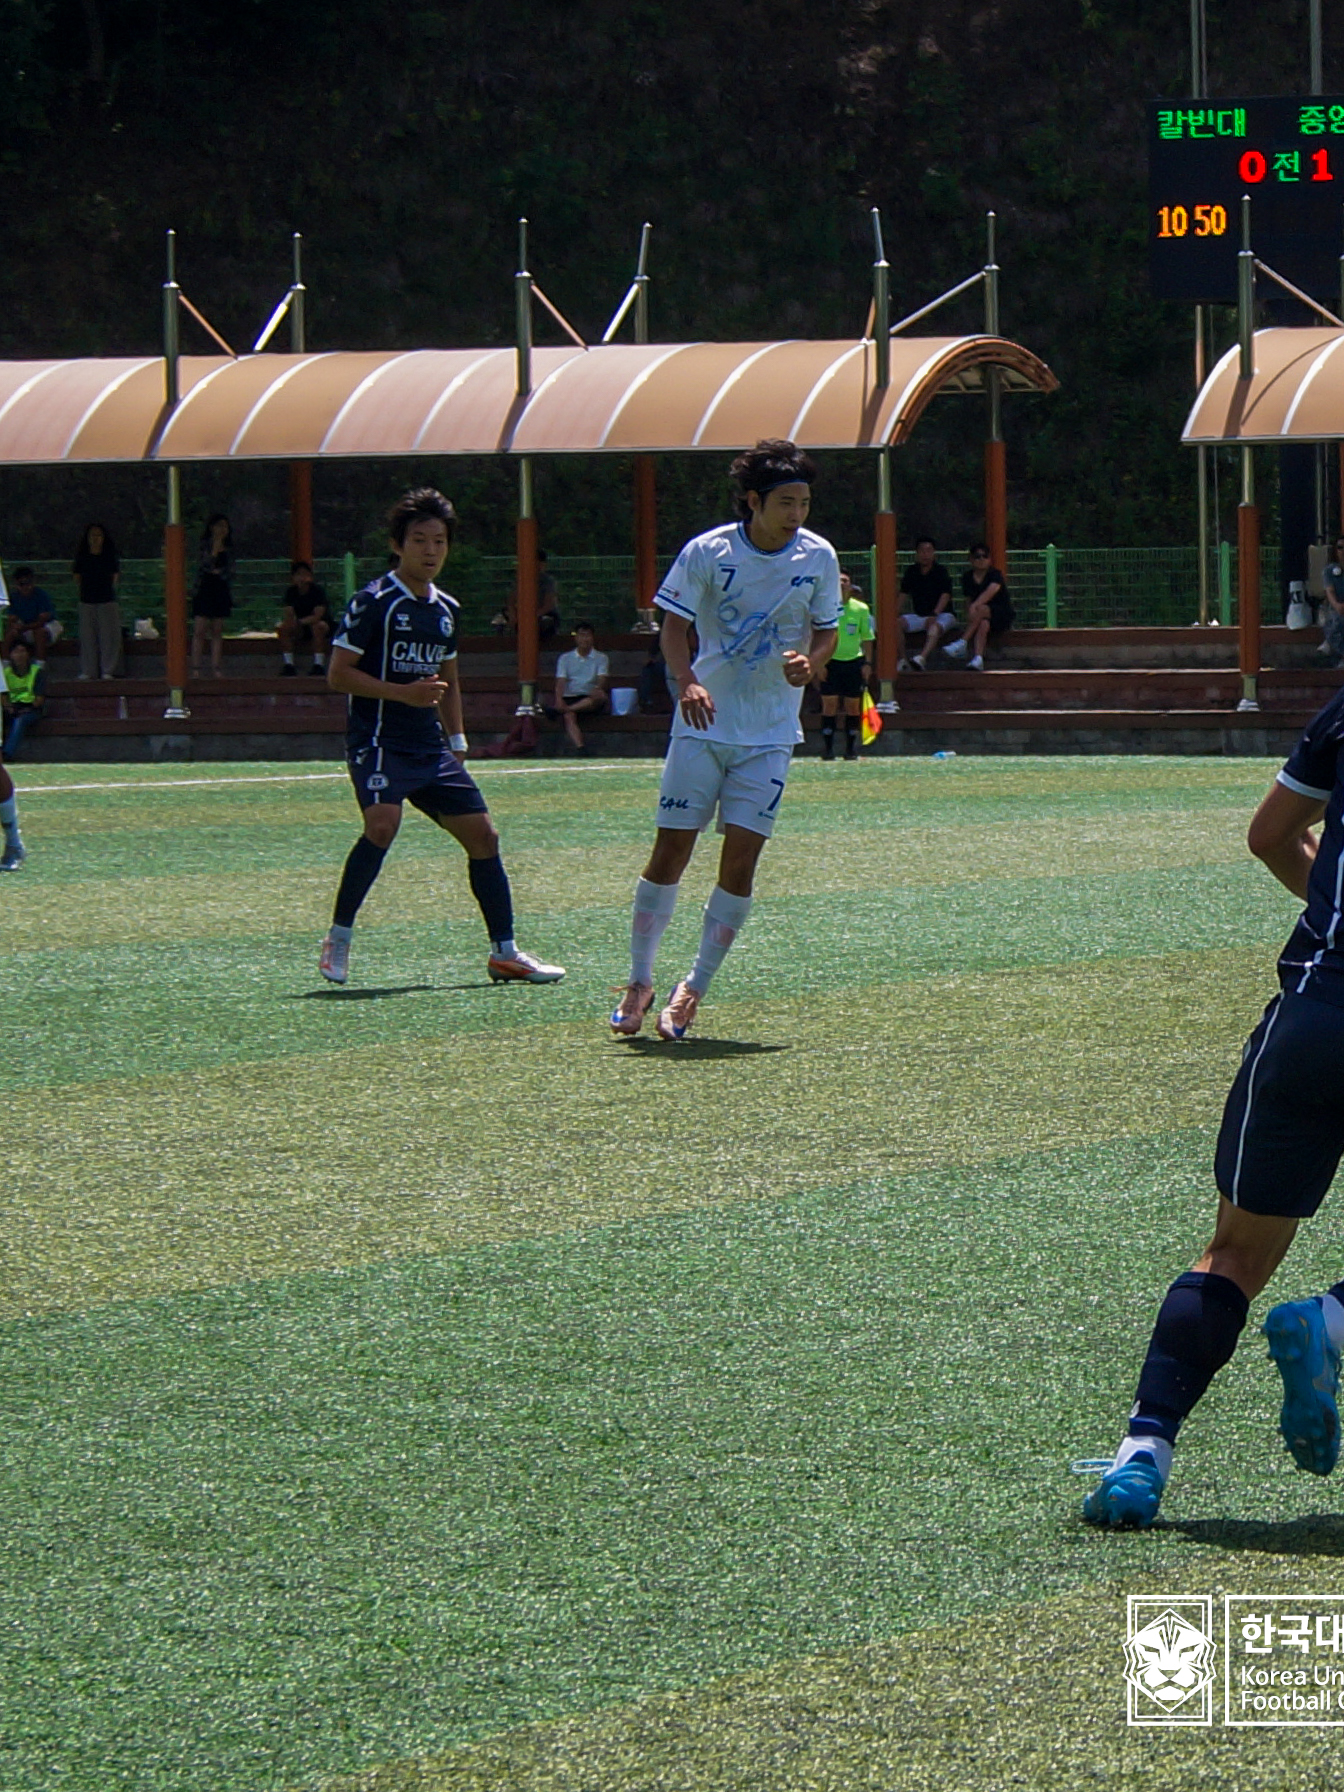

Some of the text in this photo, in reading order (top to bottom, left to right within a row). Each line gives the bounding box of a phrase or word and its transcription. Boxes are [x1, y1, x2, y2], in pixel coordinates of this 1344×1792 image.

[1157, 107, 1246, 140] 칼빈대
[1238, 148, 1334, 184] 0 전 1
[1157, 204, 1227, 238] 10 50
[720, 568, 736, 591] 7
[767, 778, 784, 811] 7
